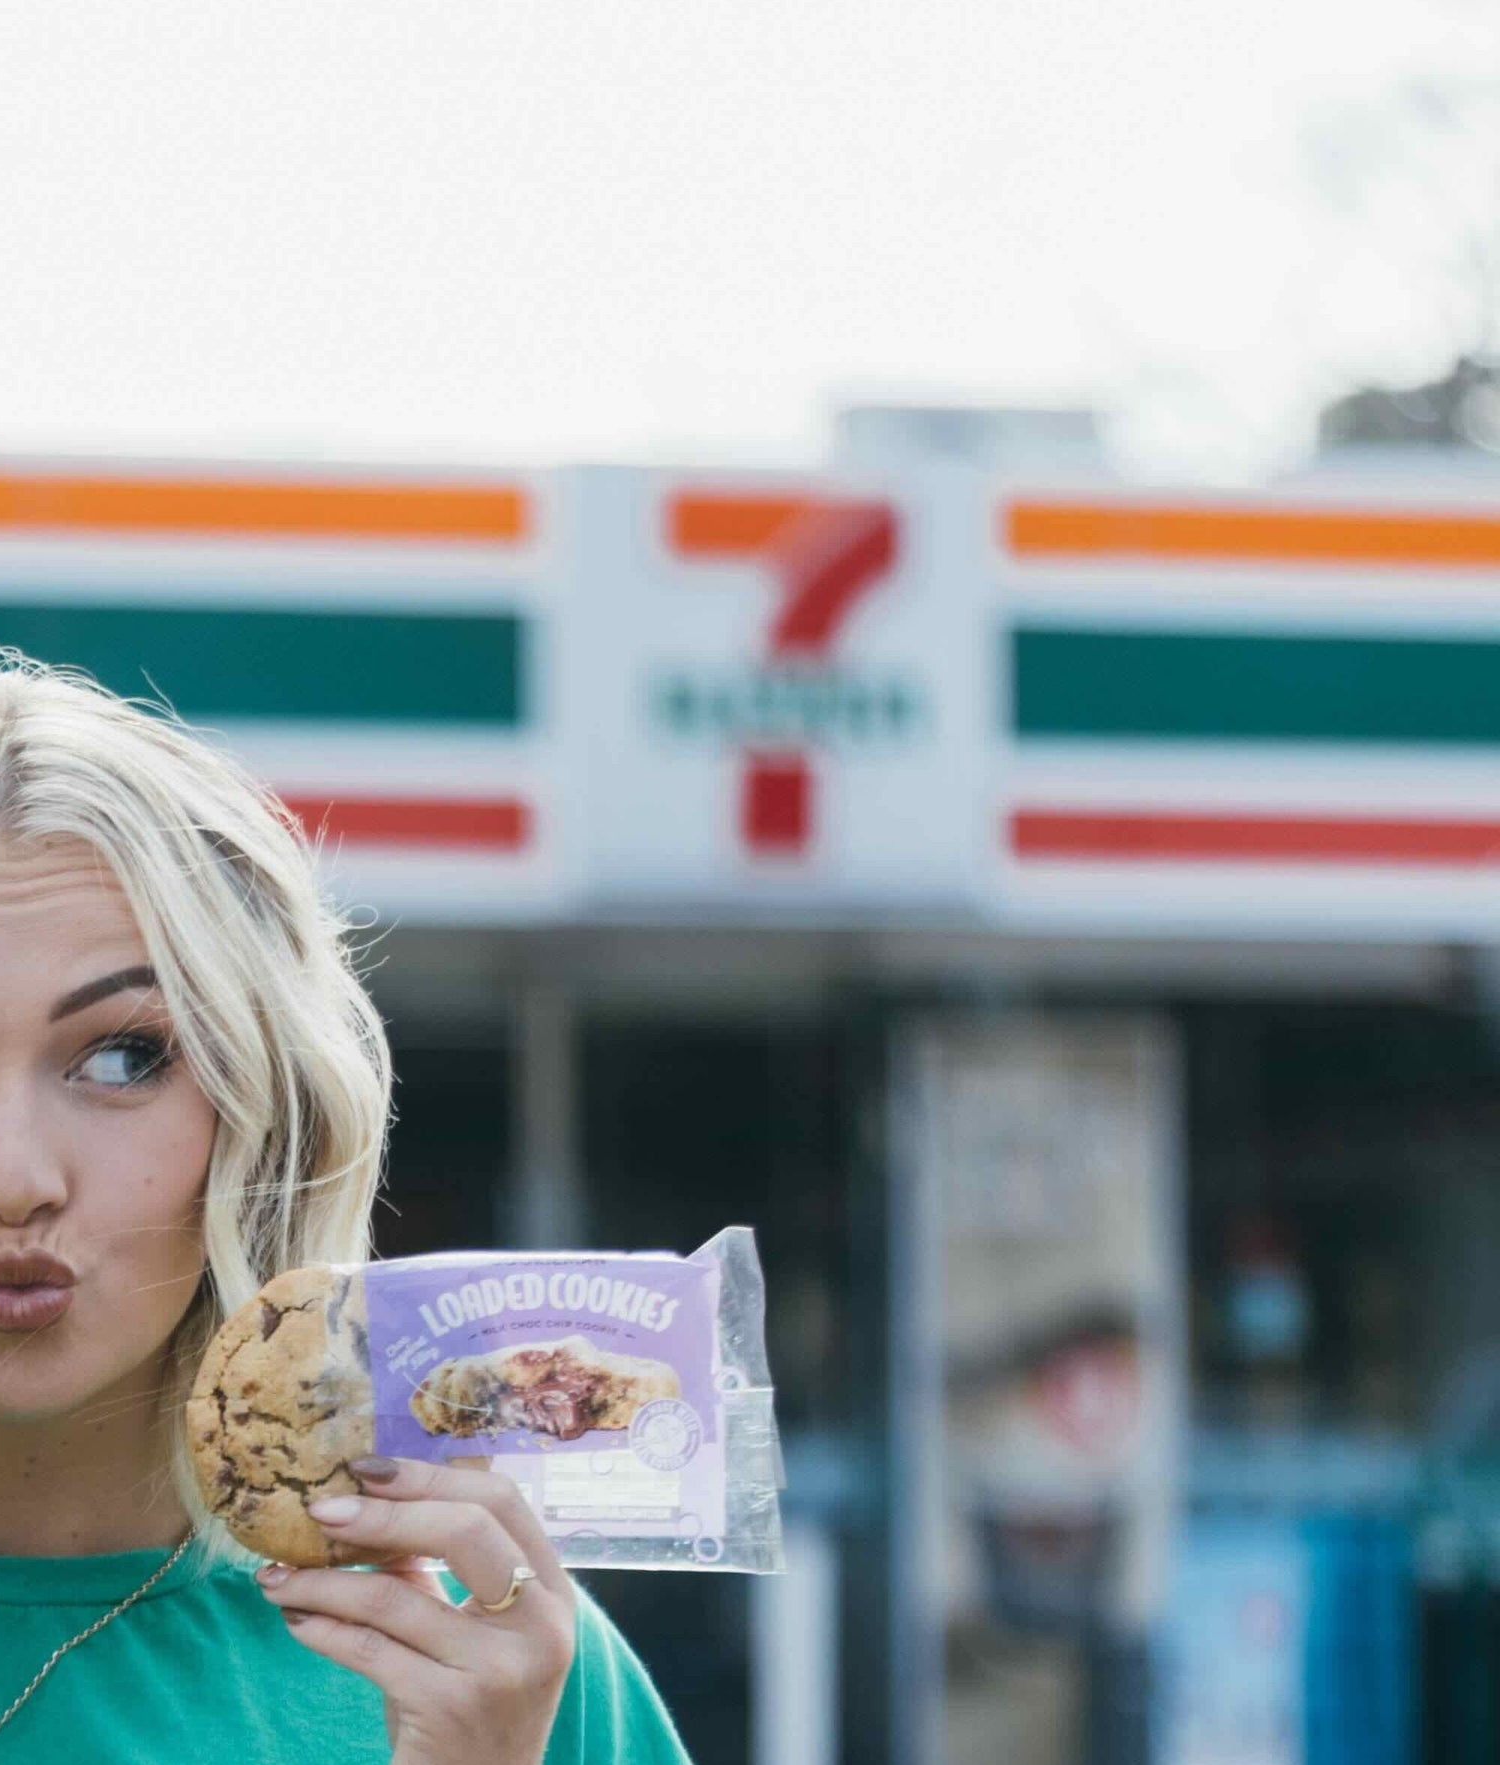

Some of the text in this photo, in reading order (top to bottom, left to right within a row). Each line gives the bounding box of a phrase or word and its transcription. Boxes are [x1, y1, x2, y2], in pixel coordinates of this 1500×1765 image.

[666, 490, 900, 855] 7
[418, 1272, 681, 1338] LOADED COOKIES
[510, 1319, 542, 1330] CHOC
[546, 1319, 571, 1329] CHIP
[575, 1321, 618, 1336] COOKIE
